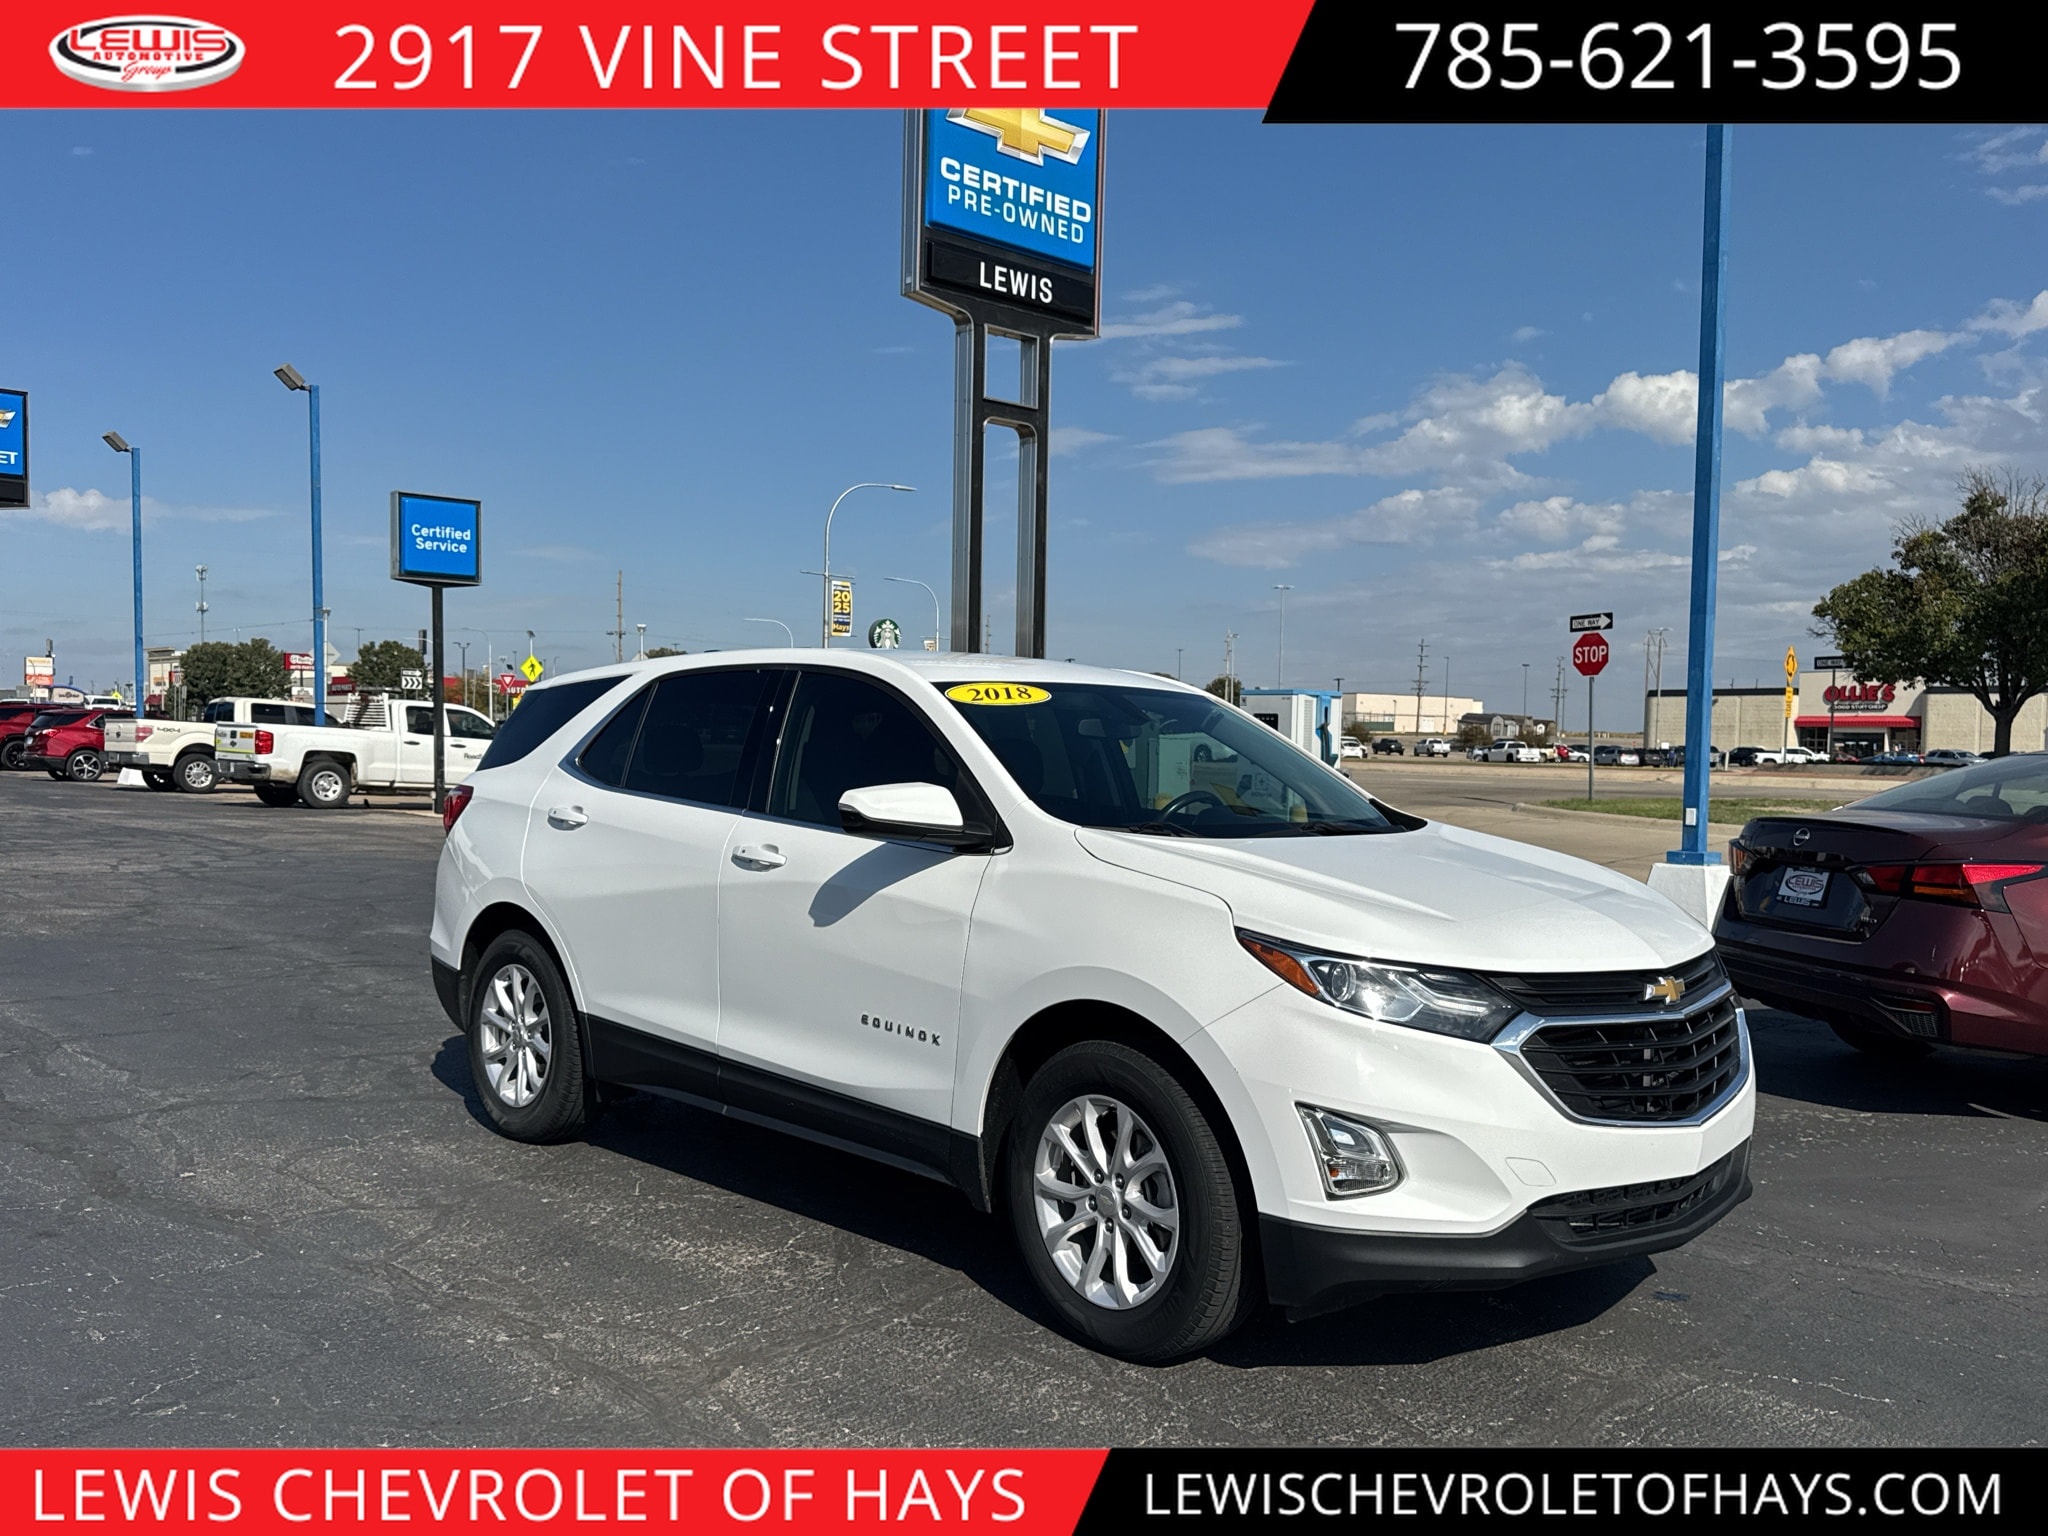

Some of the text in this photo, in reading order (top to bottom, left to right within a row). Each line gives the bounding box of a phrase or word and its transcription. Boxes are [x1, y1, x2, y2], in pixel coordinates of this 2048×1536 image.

[940, 156, 1091, 223] CERTIFIED
[948, 184, 1084, 244] PRE-OWNED
[979, 261, 1053, 304] LEWIS
[411, 523, 471, 541] Certified
[415, 537, 468, 553] Service
[1573, 618, 1600, 628] ONE WAY
[1574, 645, 1607, 664] STOP
[966, 686, 1033, 701] 2018
[1824, 683, 1896, 702] OLLIE'S
[1788, 876, 1824, 889] LEWIS
[1783, 895, 1812, 907] LEWIS
[860, 1013, 941, 1047] EQUINOX
